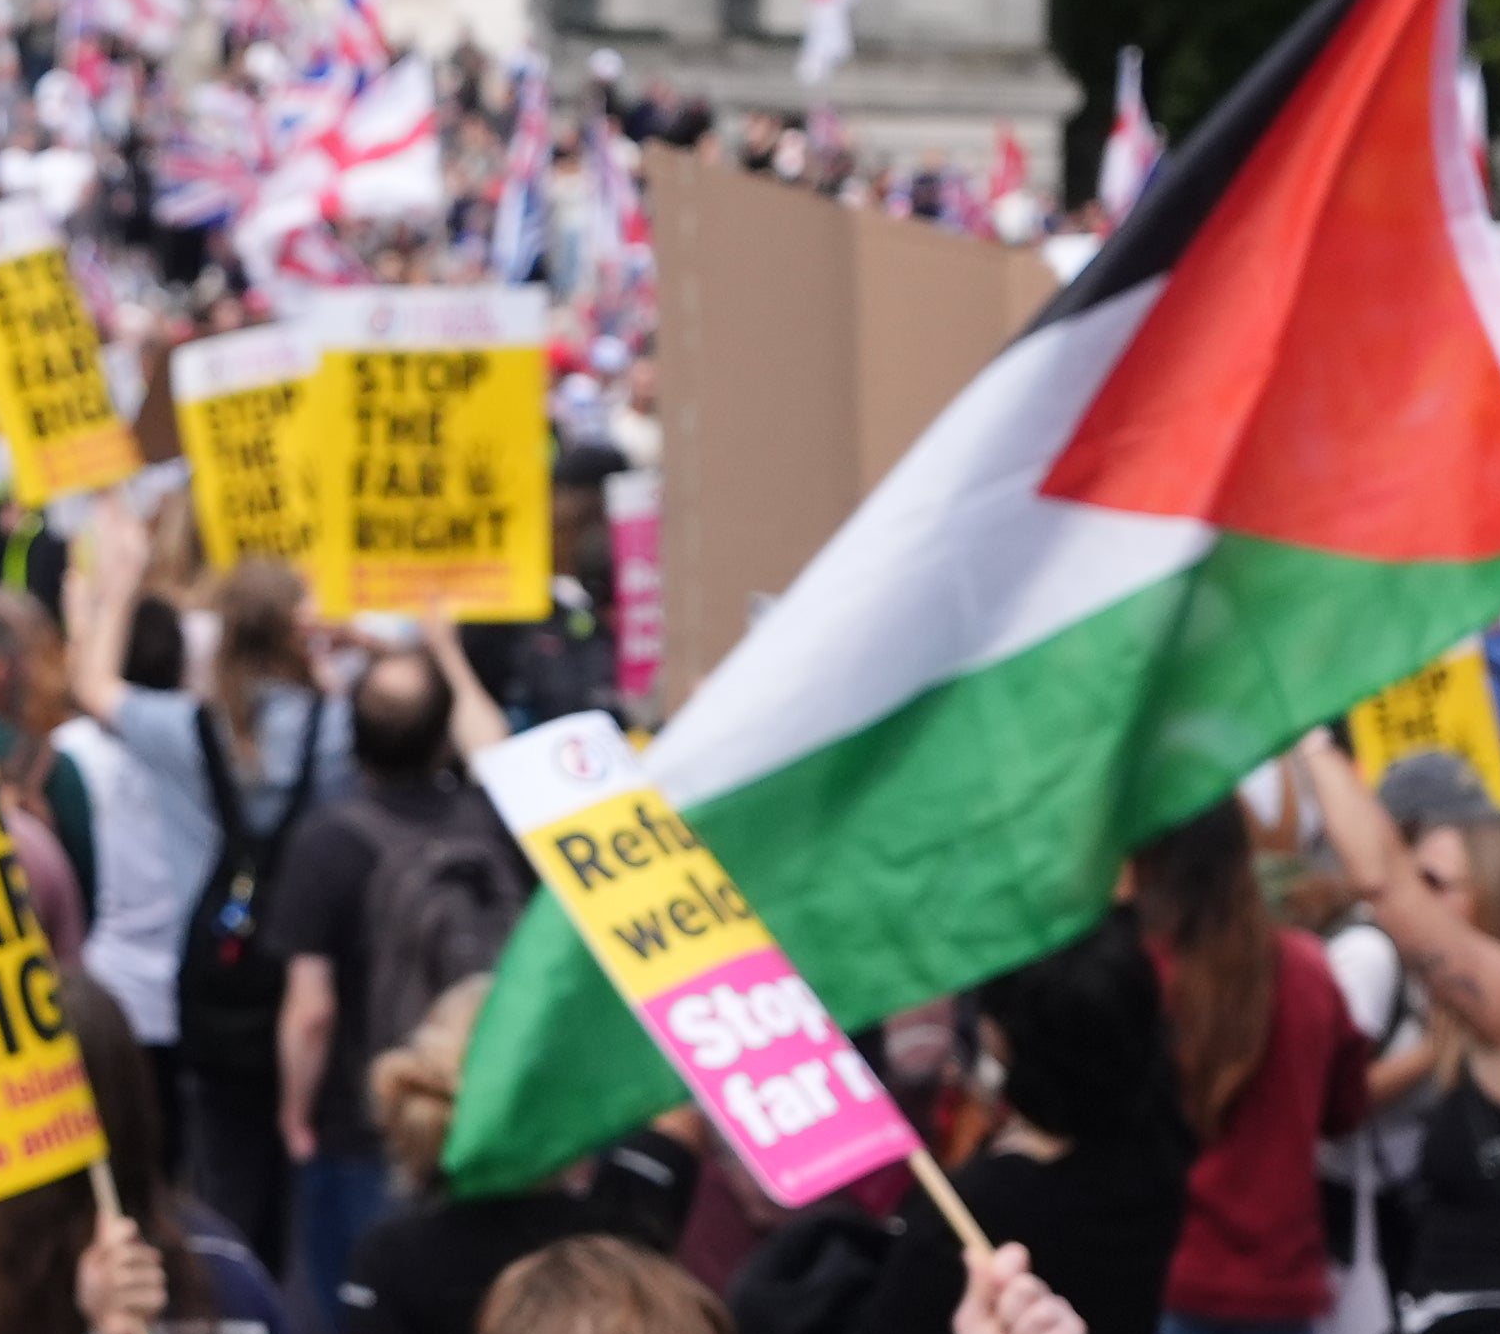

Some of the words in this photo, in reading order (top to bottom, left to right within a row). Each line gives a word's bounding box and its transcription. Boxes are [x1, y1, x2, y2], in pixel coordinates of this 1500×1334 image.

[350, 353, 489, 393] STOP
[353, 405, 443, 445] THE
[350, 457, 444, 498] FAR
[350, 505, 510, 553] RIGHT
